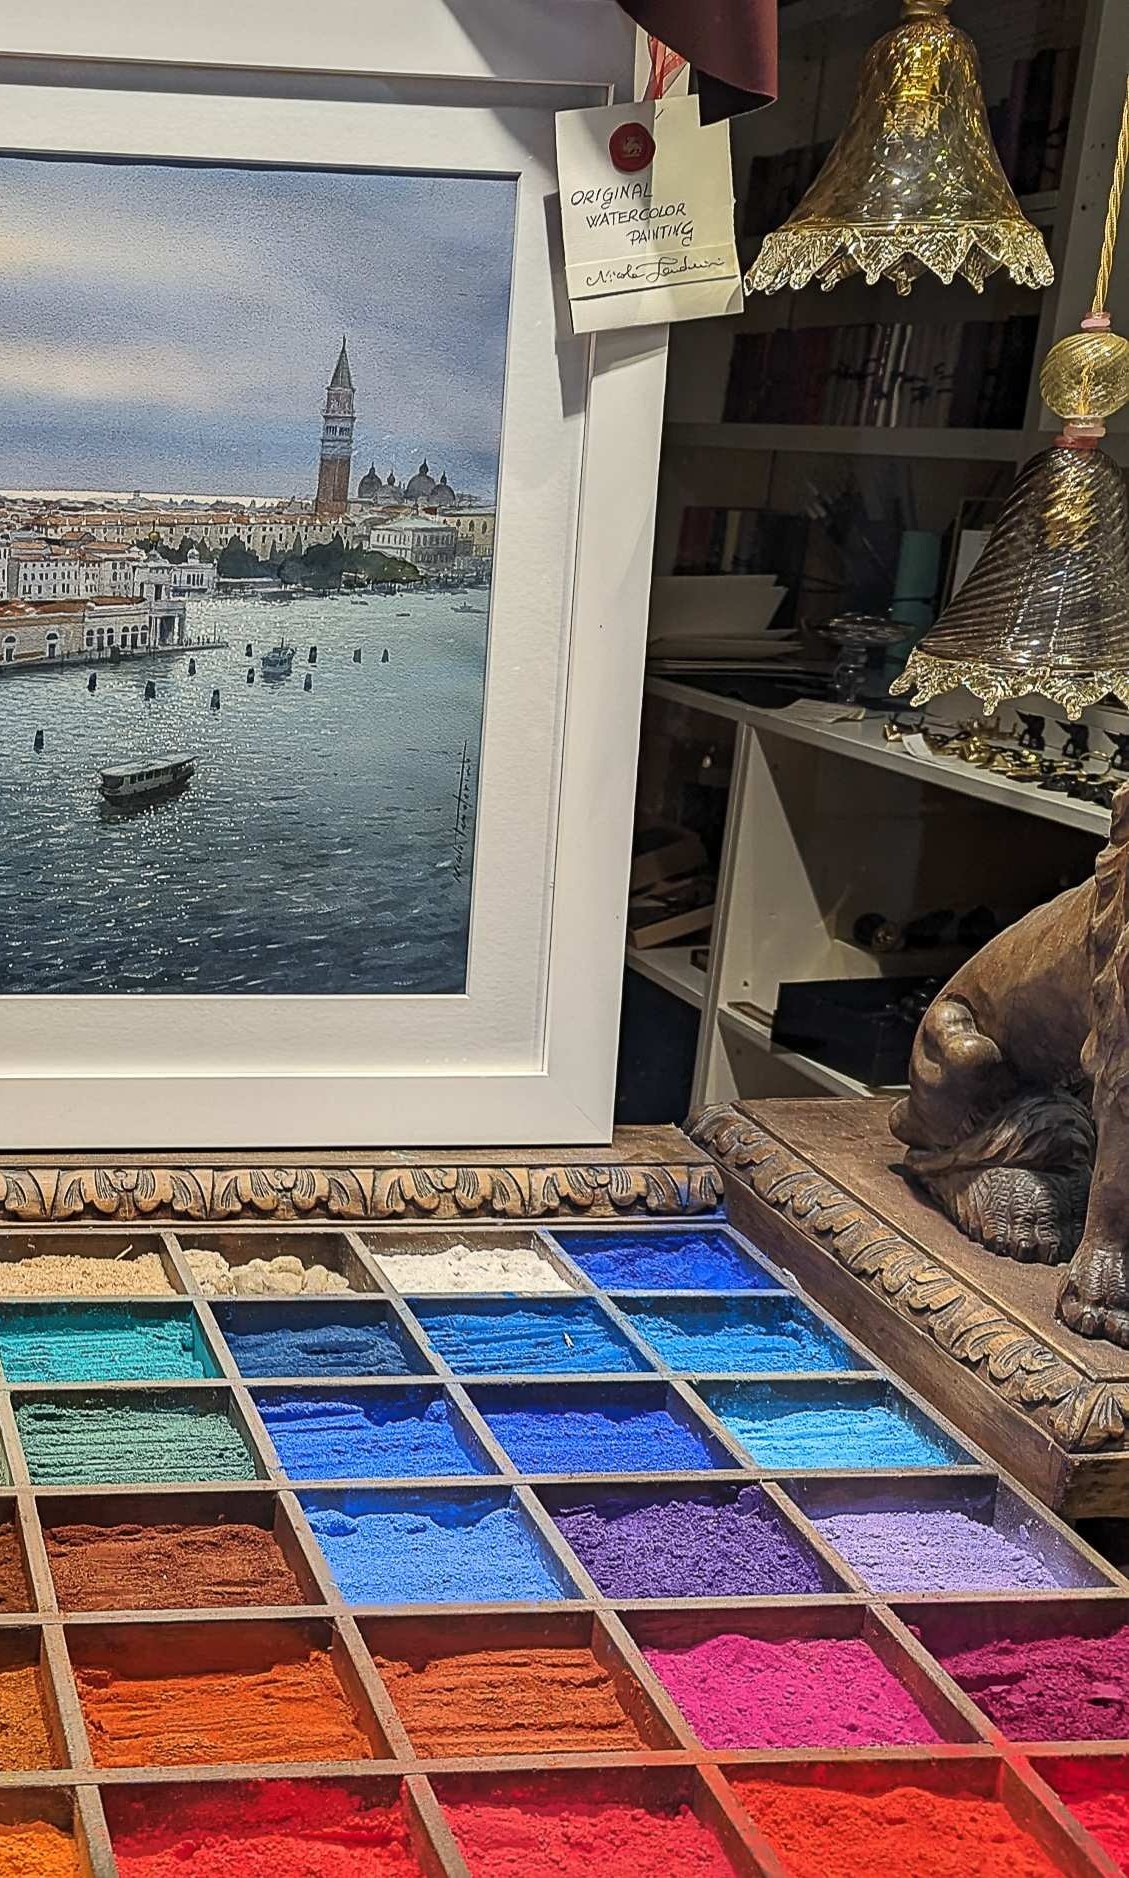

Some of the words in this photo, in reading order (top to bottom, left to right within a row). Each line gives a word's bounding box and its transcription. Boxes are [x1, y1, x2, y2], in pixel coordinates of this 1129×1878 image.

[571, 183, 653, 209] ORIGINAL
[586, 203, 686, 227] WATERCOLOR
[626, 221, 694, 246] PAINTING
